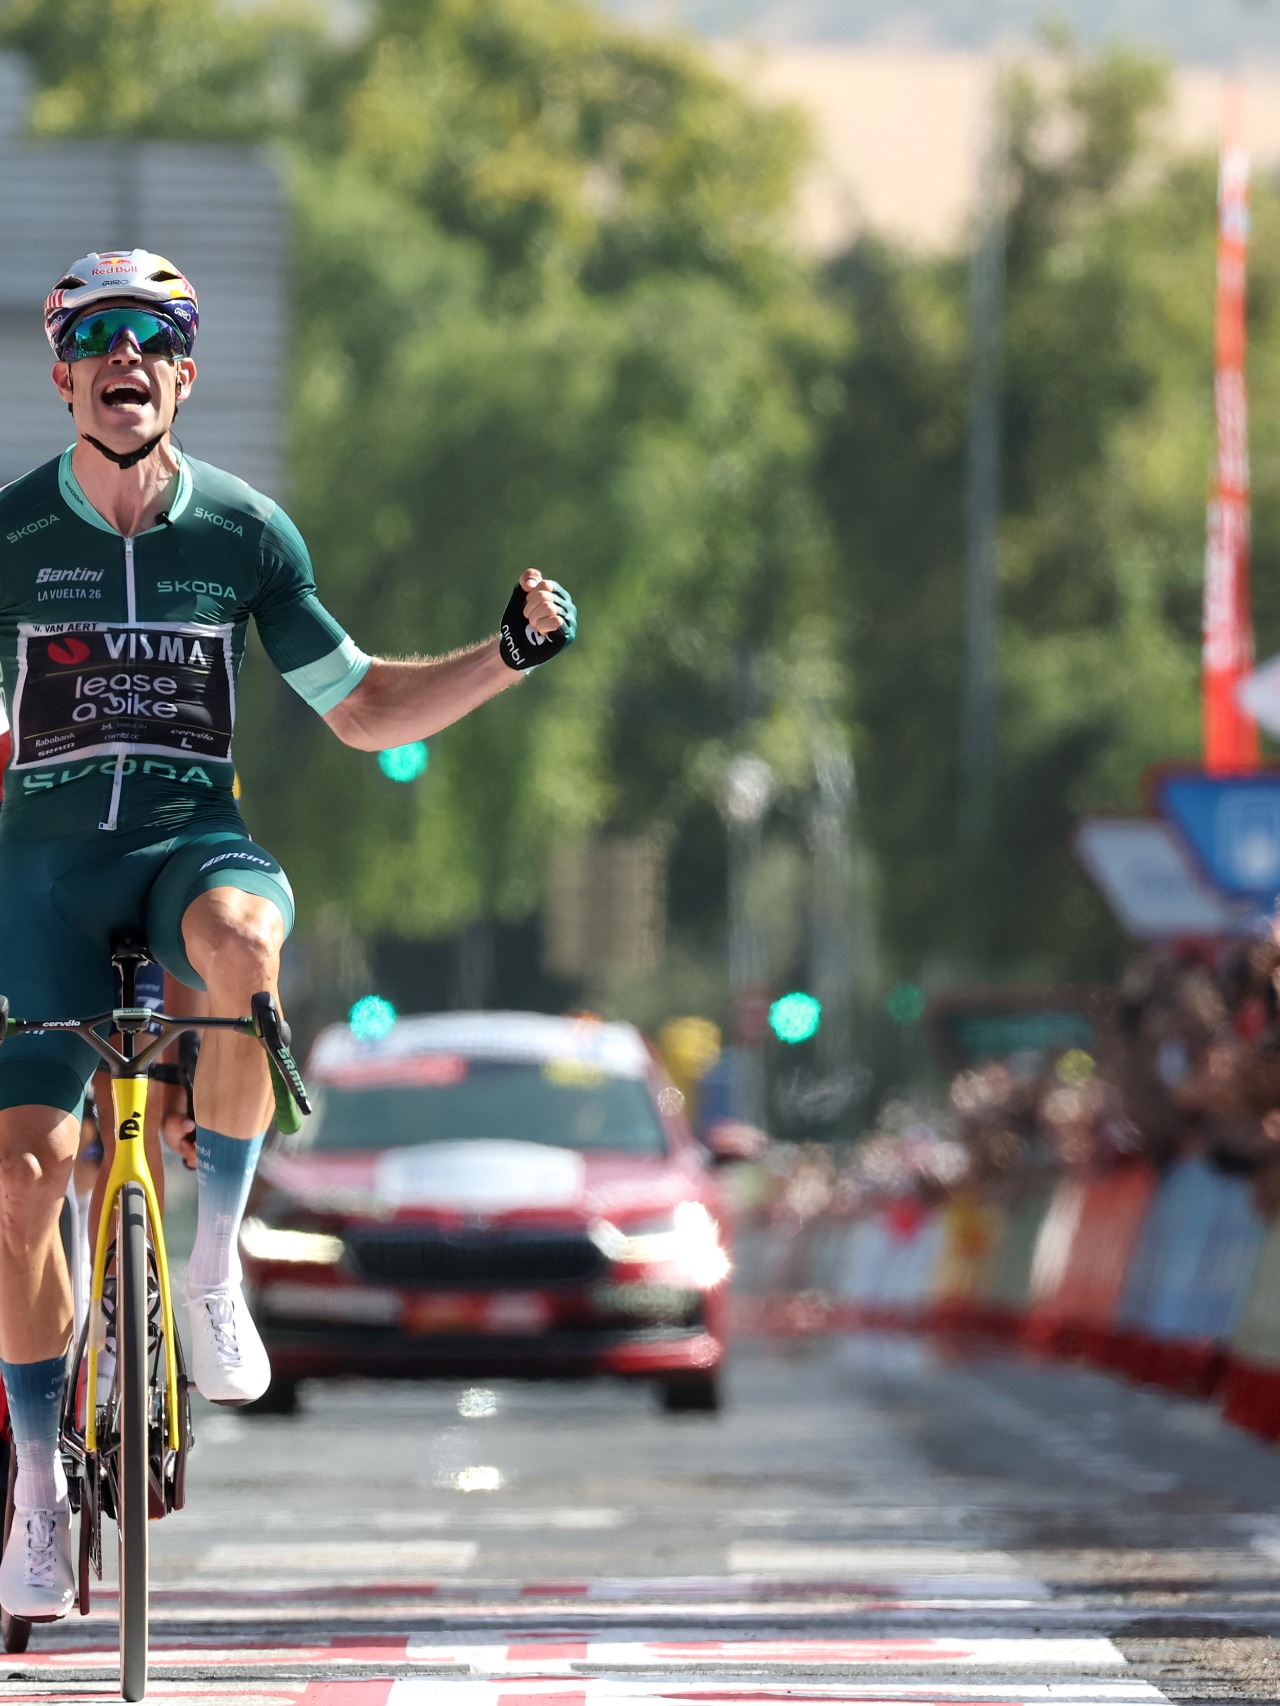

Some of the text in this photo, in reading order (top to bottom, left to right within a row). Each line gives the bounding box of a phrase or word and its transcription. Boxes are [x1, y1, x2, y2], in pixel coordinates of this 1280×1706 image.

[91, 265, 138, 276] Red Bull
[102, 279, 129, 287] GIRO
[36, 567, 105, 584] Santini
[37, 588, 102, 602] LA VUELTA 26
[45, 623, 65, 633] VAN
[67, 623, 99, 632] AERT
[103, 632, 207, 666] VISMA
[502, 624, 526, 666] nimbl
[75, 673, 178, 699] lease
[71, 702, 97, 722] a
[35, 732, 76, 748] Rabobank
[42, 1019, 81, 1028] cervélo
[277, 1047, 308, 1099] SRAM
